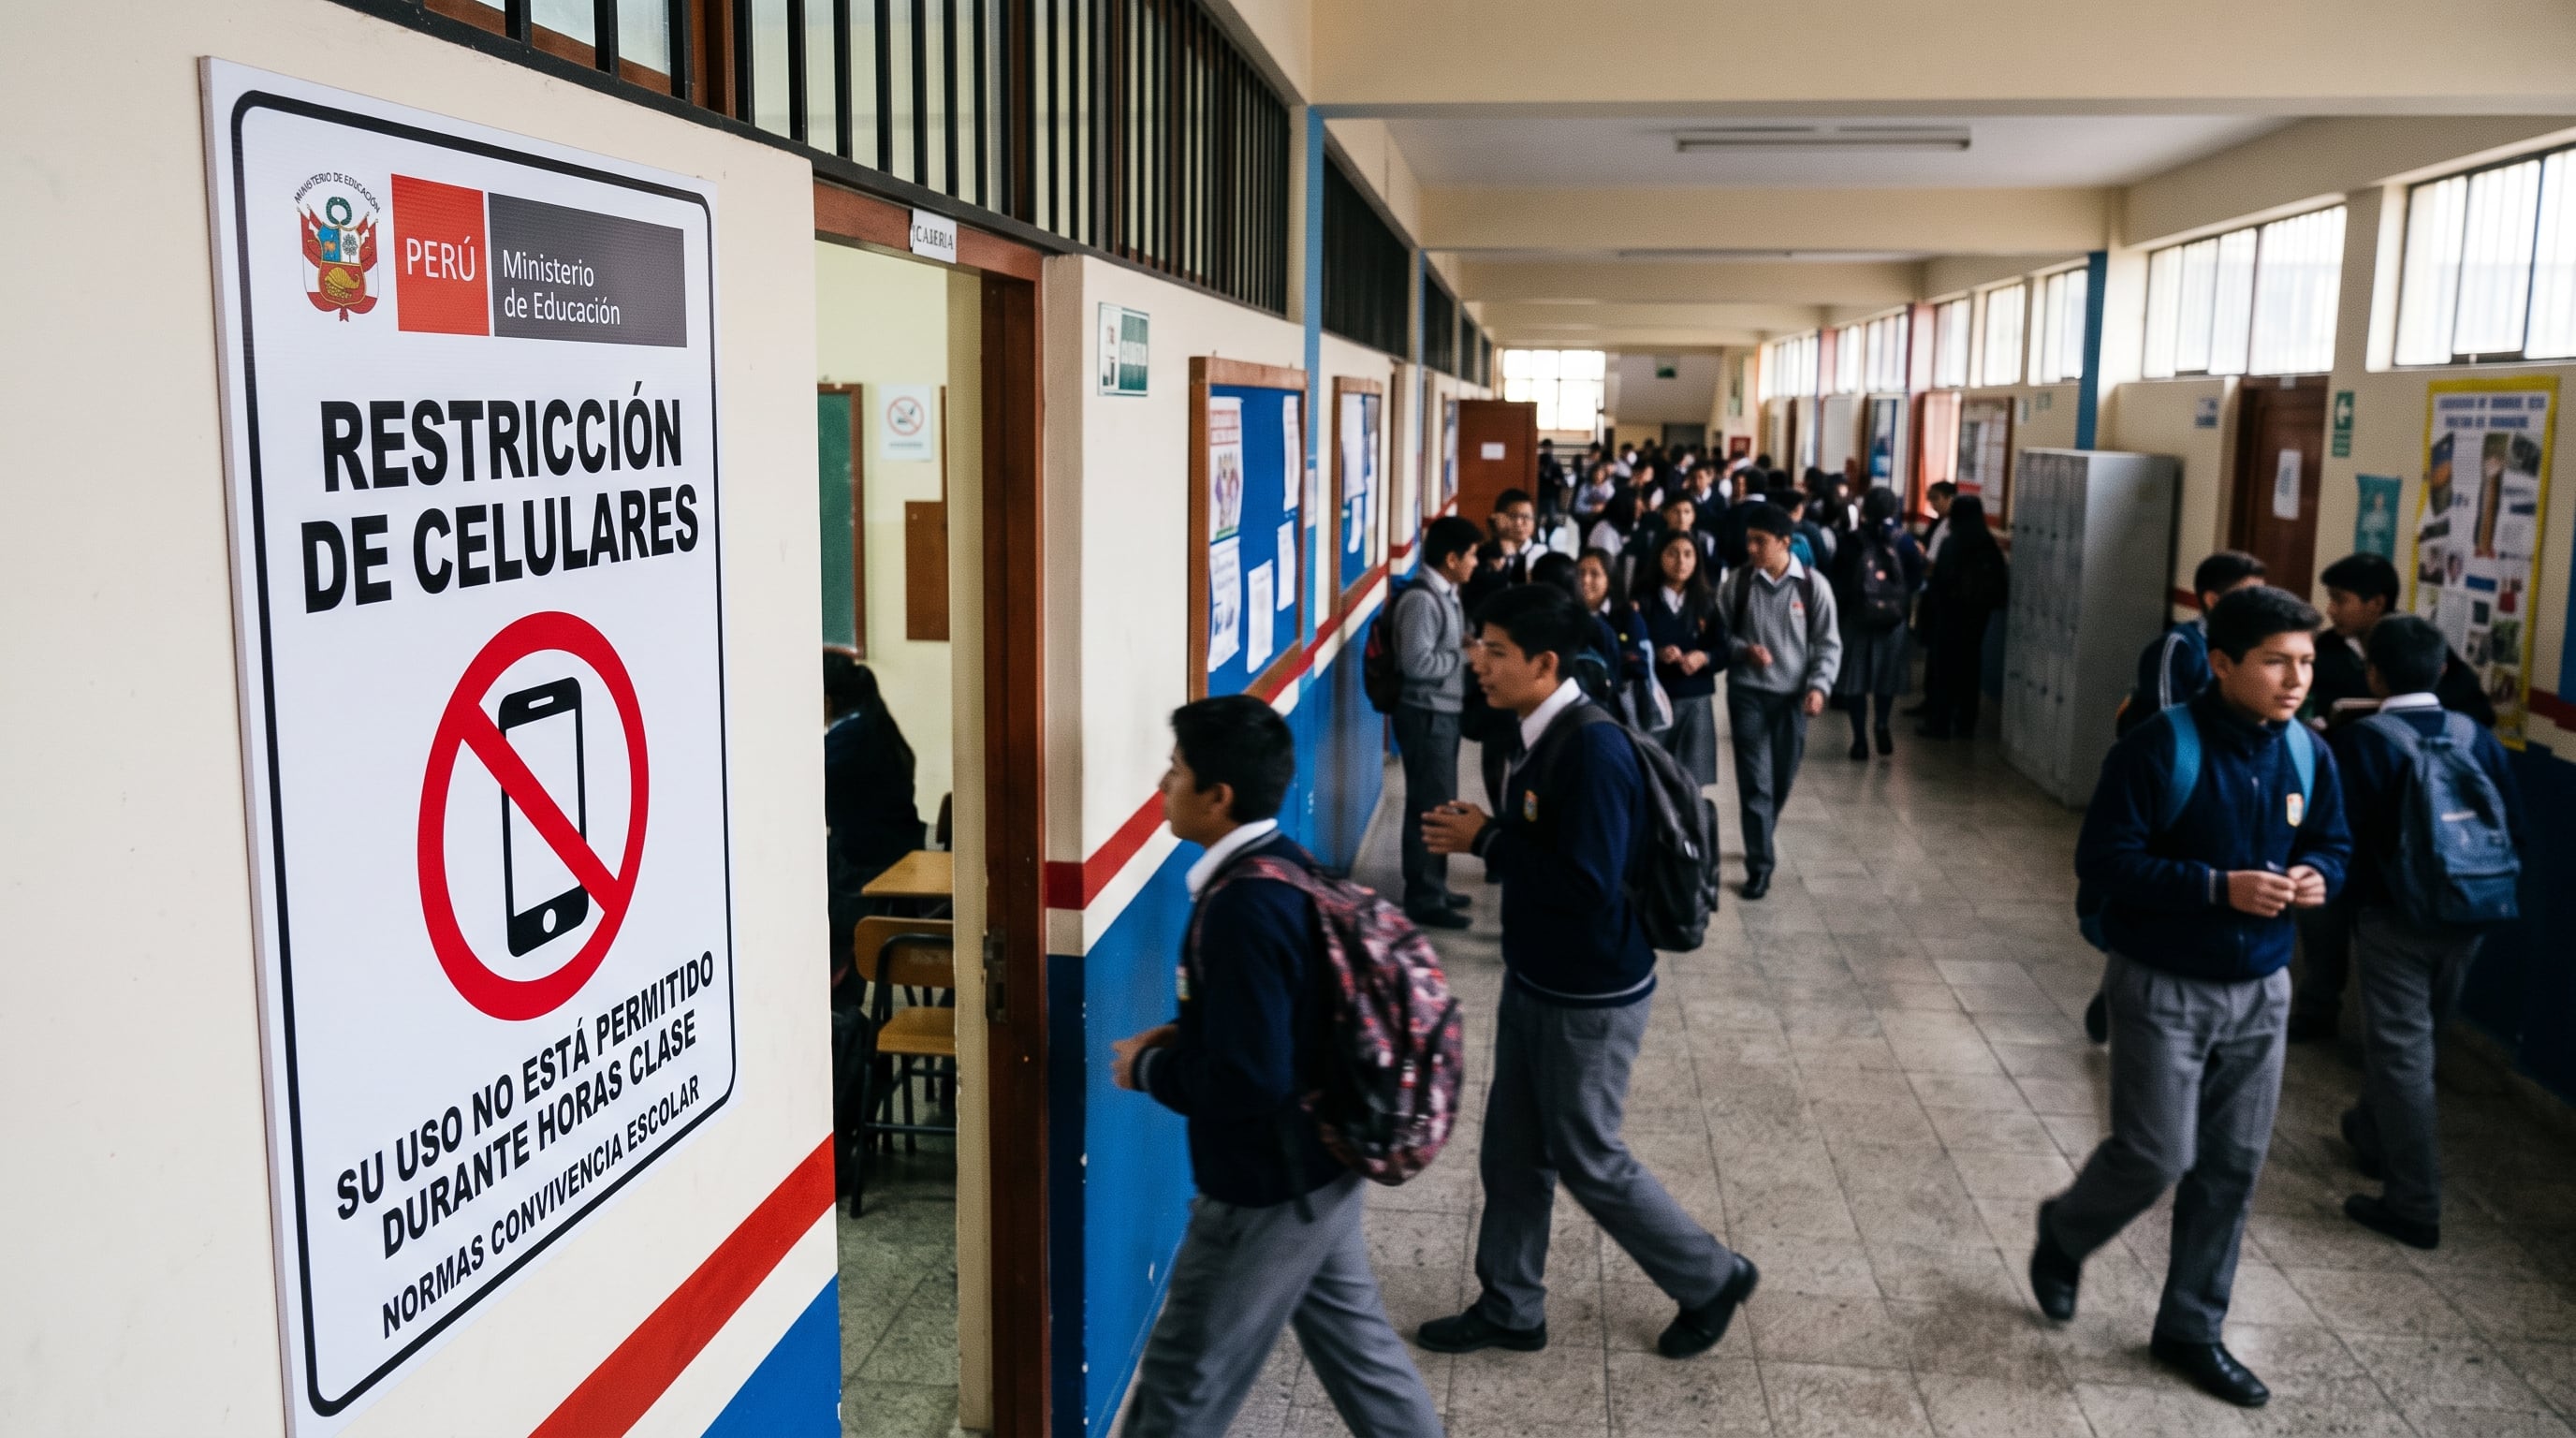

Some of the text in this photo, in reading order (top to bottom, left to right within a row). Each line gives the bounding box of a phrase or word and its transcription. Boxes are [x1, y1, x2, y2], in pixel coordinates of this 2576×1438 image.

[333, 172, 344, 183] DE
[405, 235, 476, 283] PERÚ
[503, 249, 595, 288] Ministerio
[504, 286, 622, 327] de Educación
[320, 381, 683, 492] RESTRICCIÓN
[300, 483, 700, 615] DE CELULARES
[336, 950, 714, 1222] SU USO NO ESTÁ PERMITIDO
[382, 1008, 697, 1261] DURANTE HORAS CLASE
[382, 1074, 700, 1341] NORMAS CONVIVENCIA ESCOLAR
